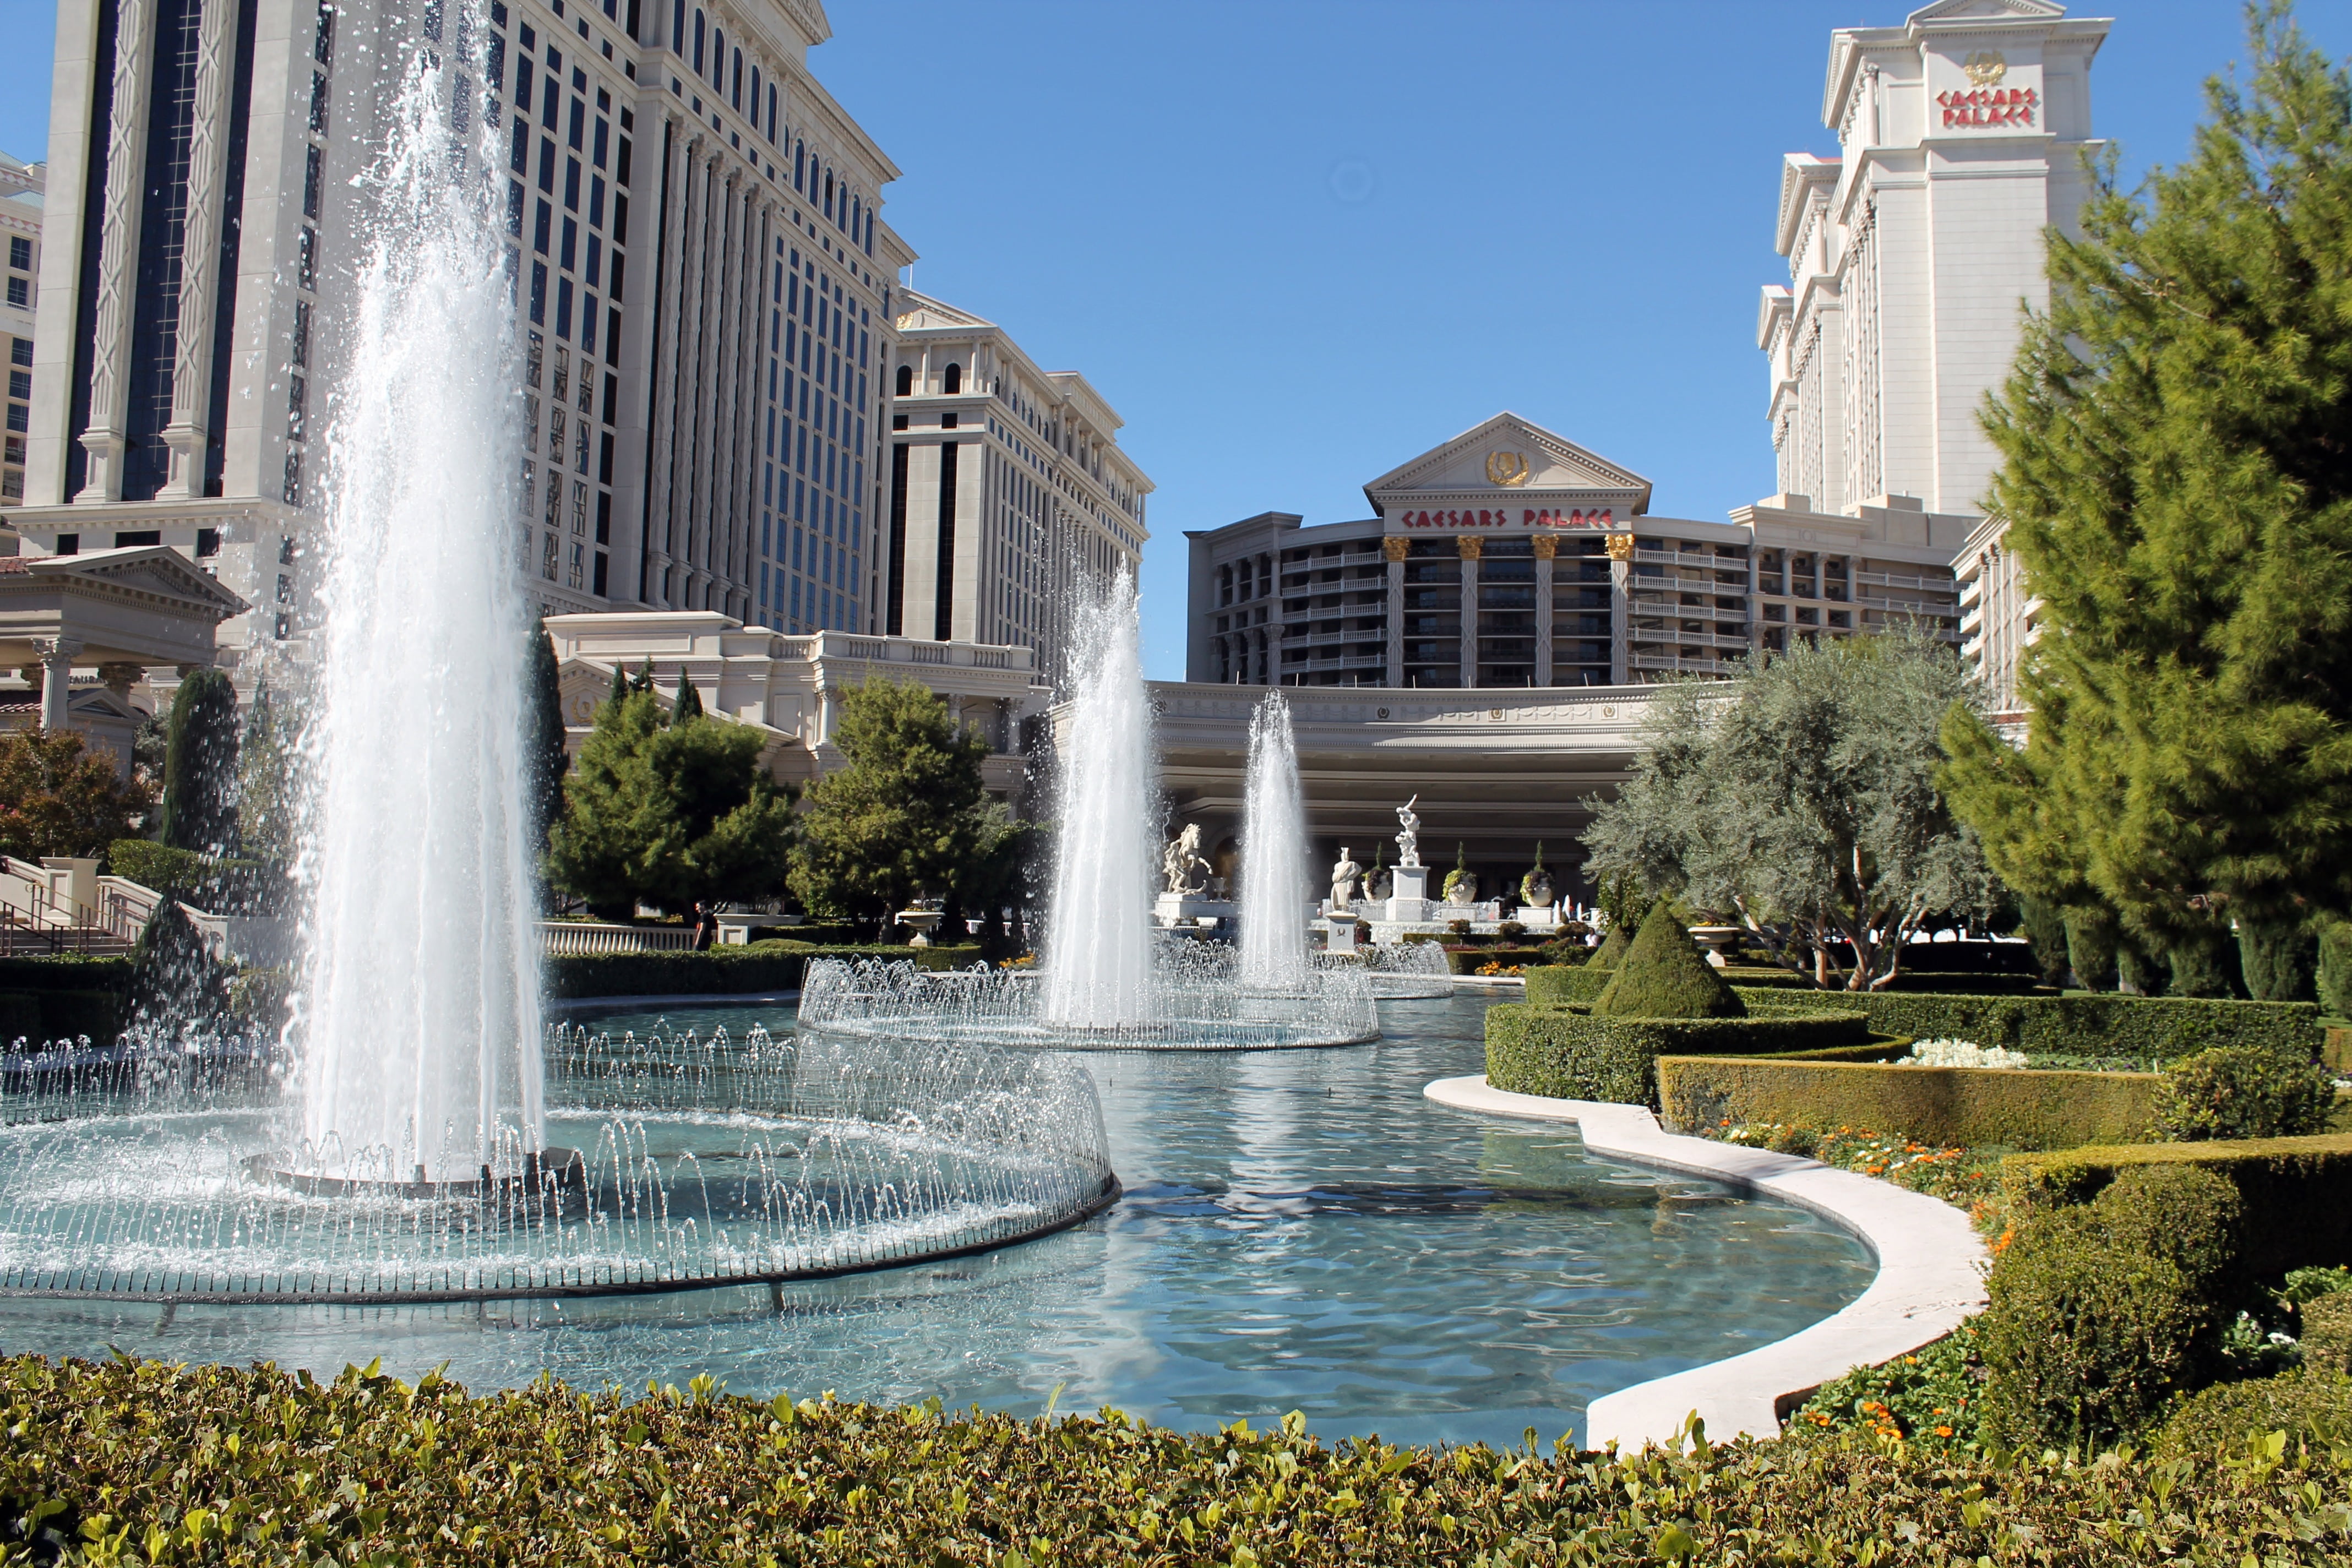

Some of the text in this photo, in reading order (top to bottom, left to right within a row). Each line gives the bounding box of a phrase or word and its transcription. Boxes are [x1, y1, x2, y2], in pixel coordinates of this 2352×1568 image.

[1936, 88, 2037, 107] CAESARS
[1943, 106, 2033, 127] PALACE
[1401, 508, 1613, 528] CAESARS PALACE
